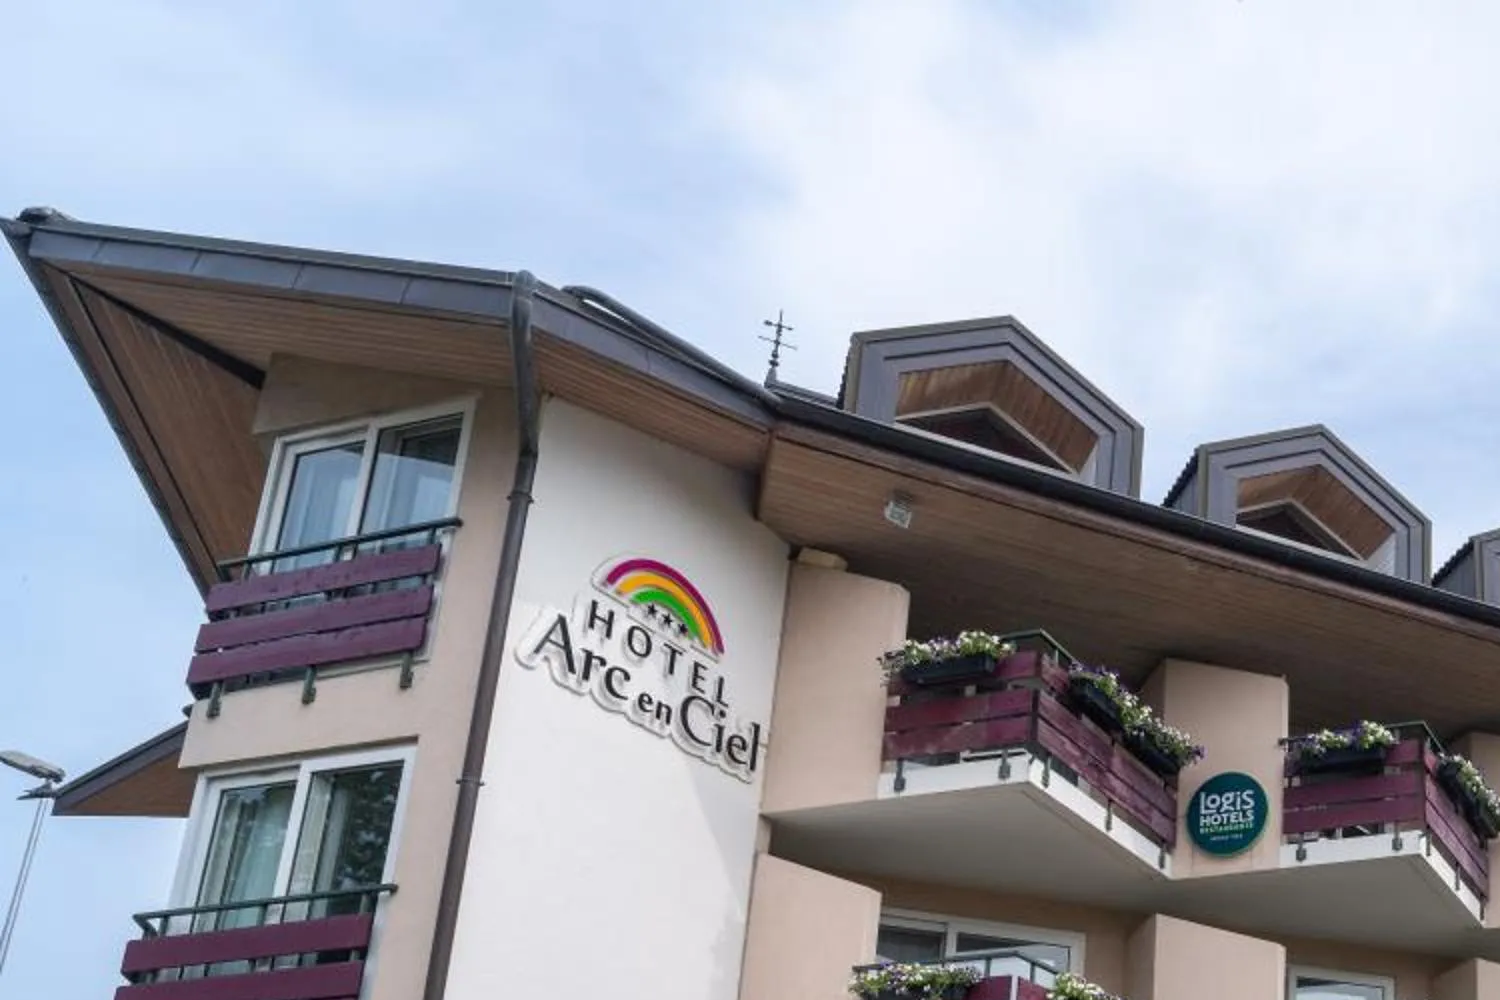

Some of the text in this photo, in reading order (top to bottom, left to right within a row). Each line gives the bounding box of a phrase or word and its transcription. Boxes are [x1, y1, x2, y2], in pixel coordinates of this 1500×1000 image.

[533, 613, 761, 772] Arc en Ciel
[588, 599, 729, 708] HOTEL
[1199, 809, 1255, 827] HOTELS
